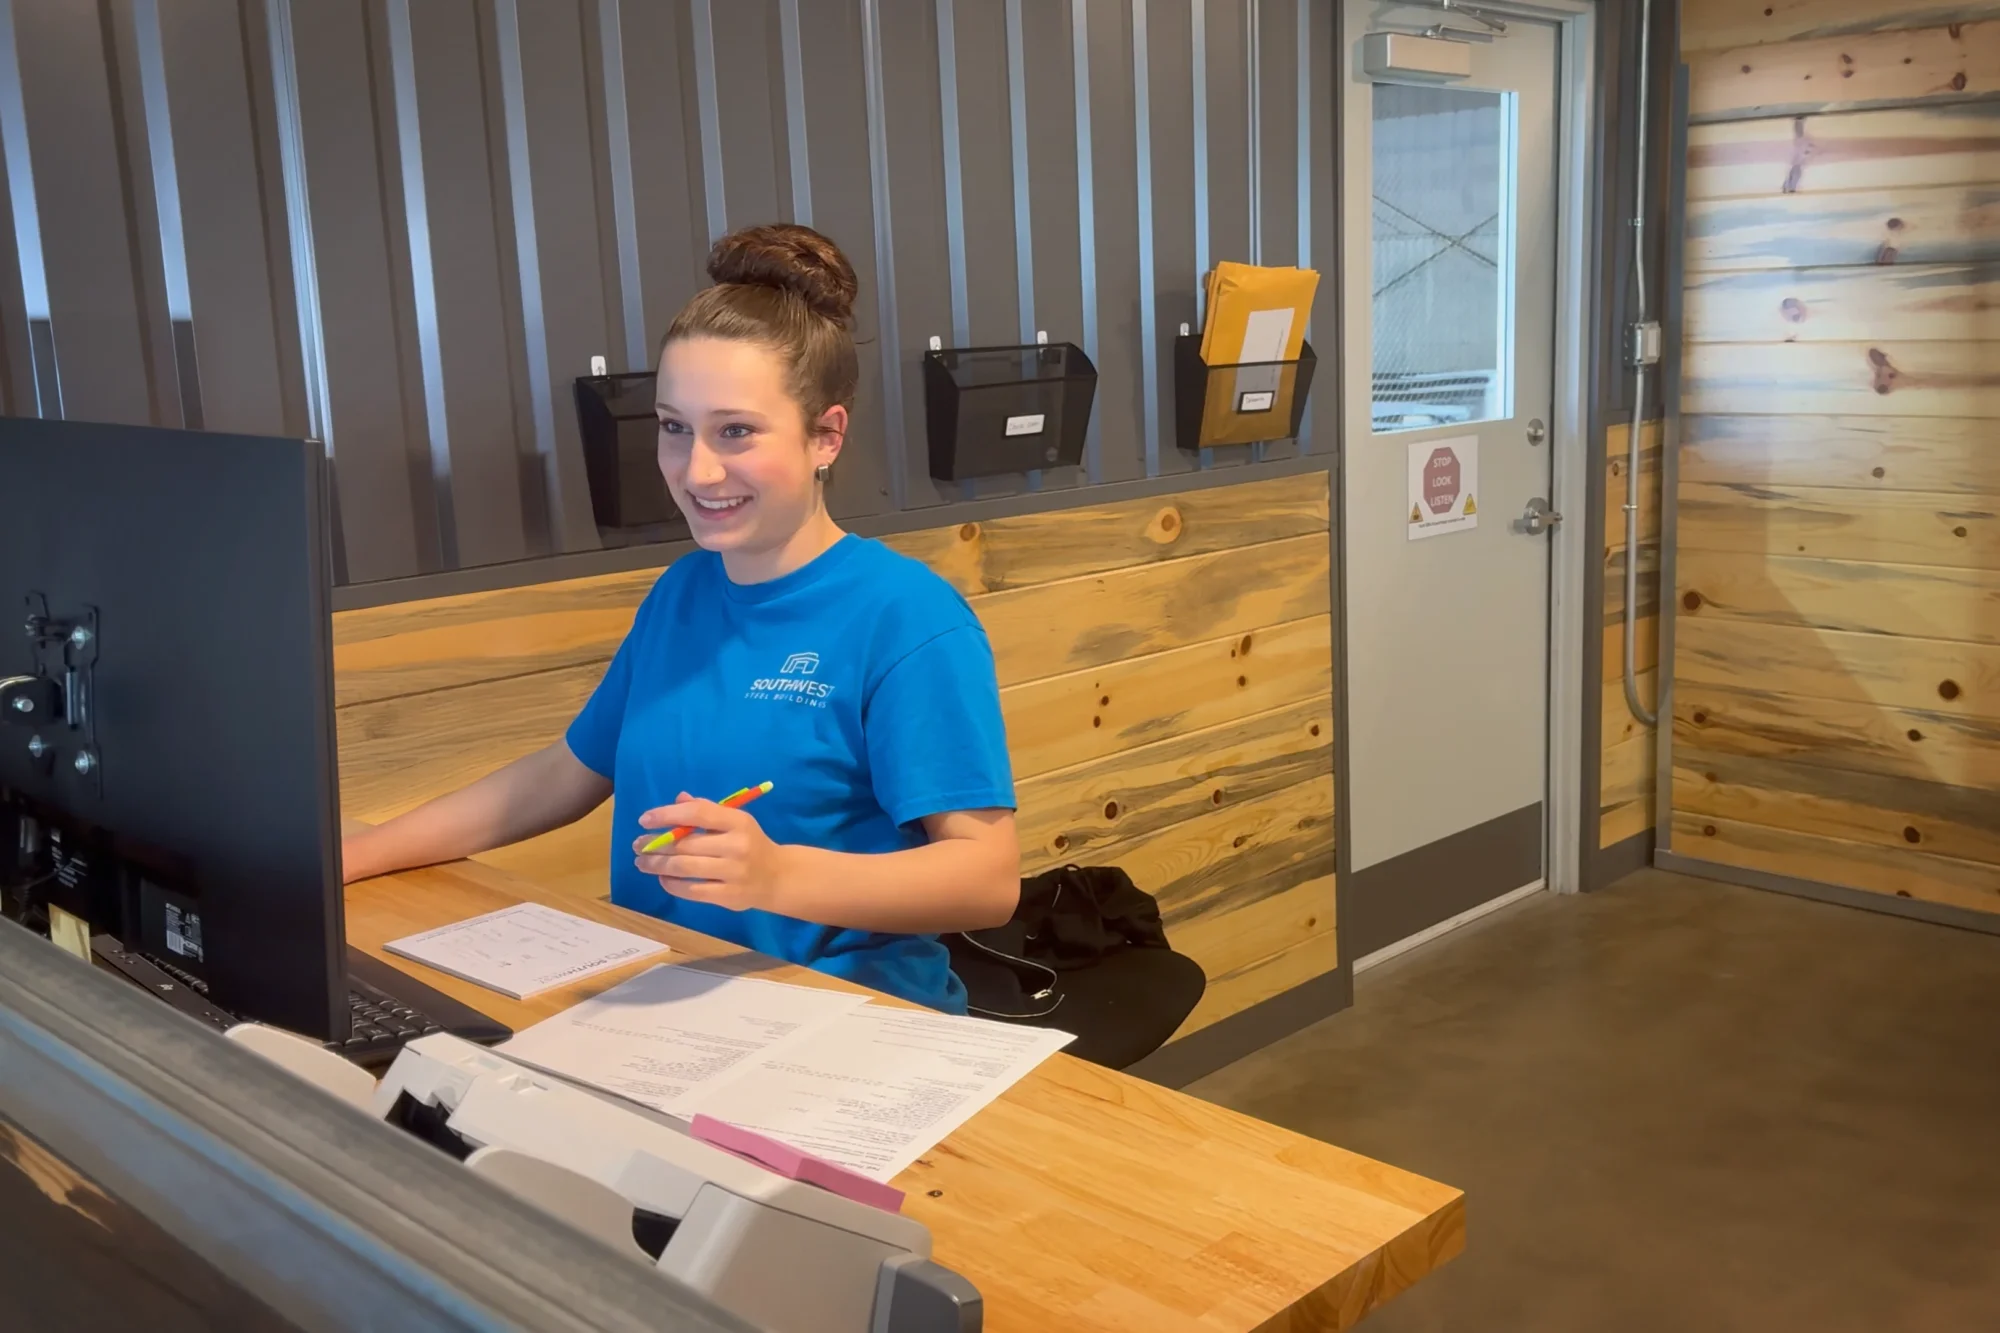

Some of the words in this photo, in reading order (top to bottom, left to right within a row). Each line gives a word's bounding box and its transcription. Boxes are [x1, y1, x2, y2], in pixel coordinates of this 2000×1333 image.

[1433, 456, 1452, 468] STOP
[1432, 475, 1452, 487] LOOK
[1430, 494, 1454, 507] LISTEN
[750, 678, 835, 698] SOUTHWEST
[744, 691, 769, 700] STEEL
